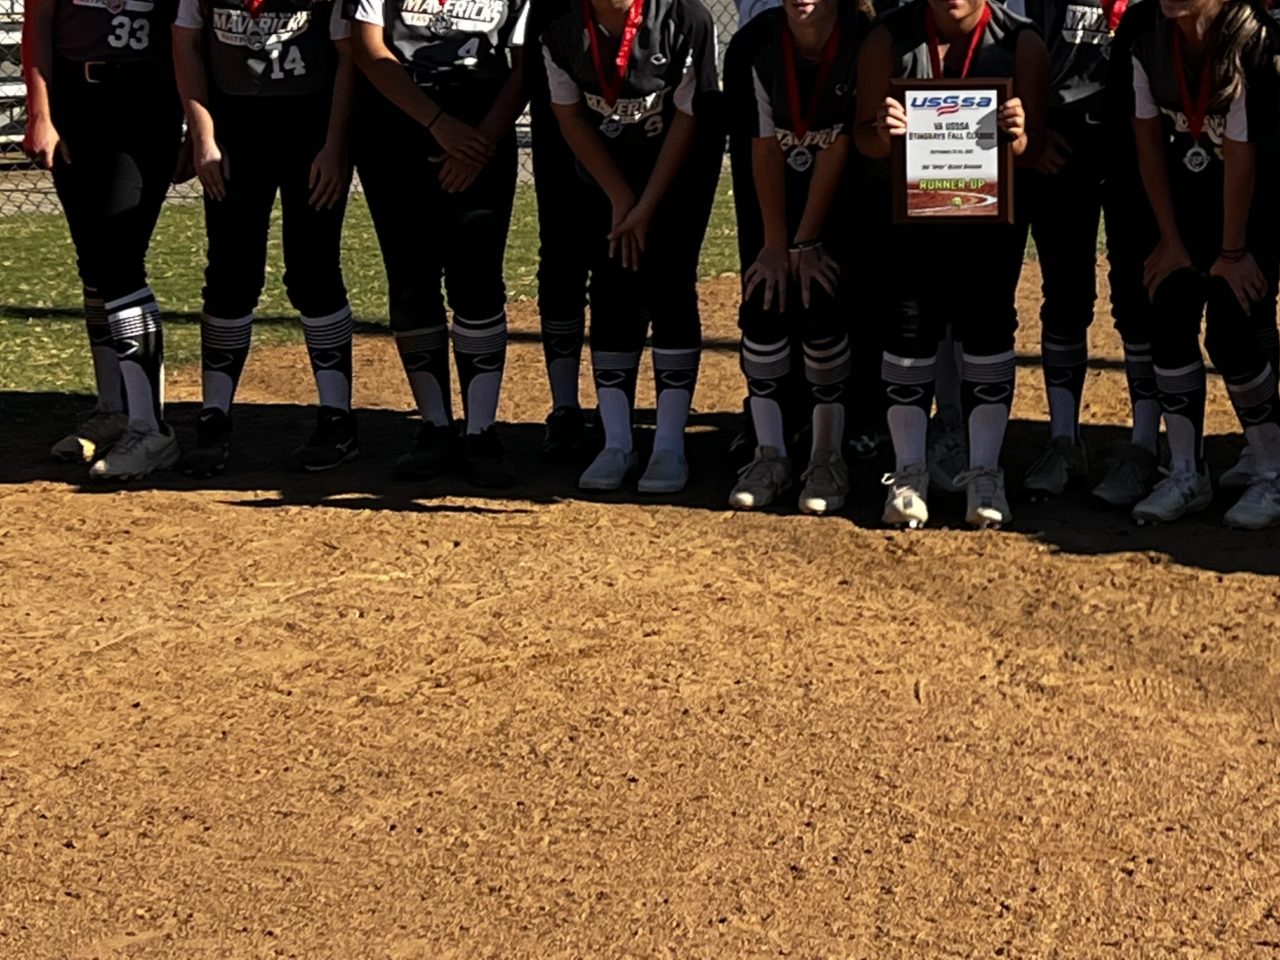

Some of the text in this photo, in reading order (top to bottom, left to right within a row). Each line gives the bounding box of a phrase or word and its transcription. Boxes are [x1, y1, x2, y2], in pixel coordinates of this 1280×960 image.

[107, 15, 150, 50] 33
[265, 43, 306, 79] 14
[919, 178, 986, 190] RUNNER-UP
